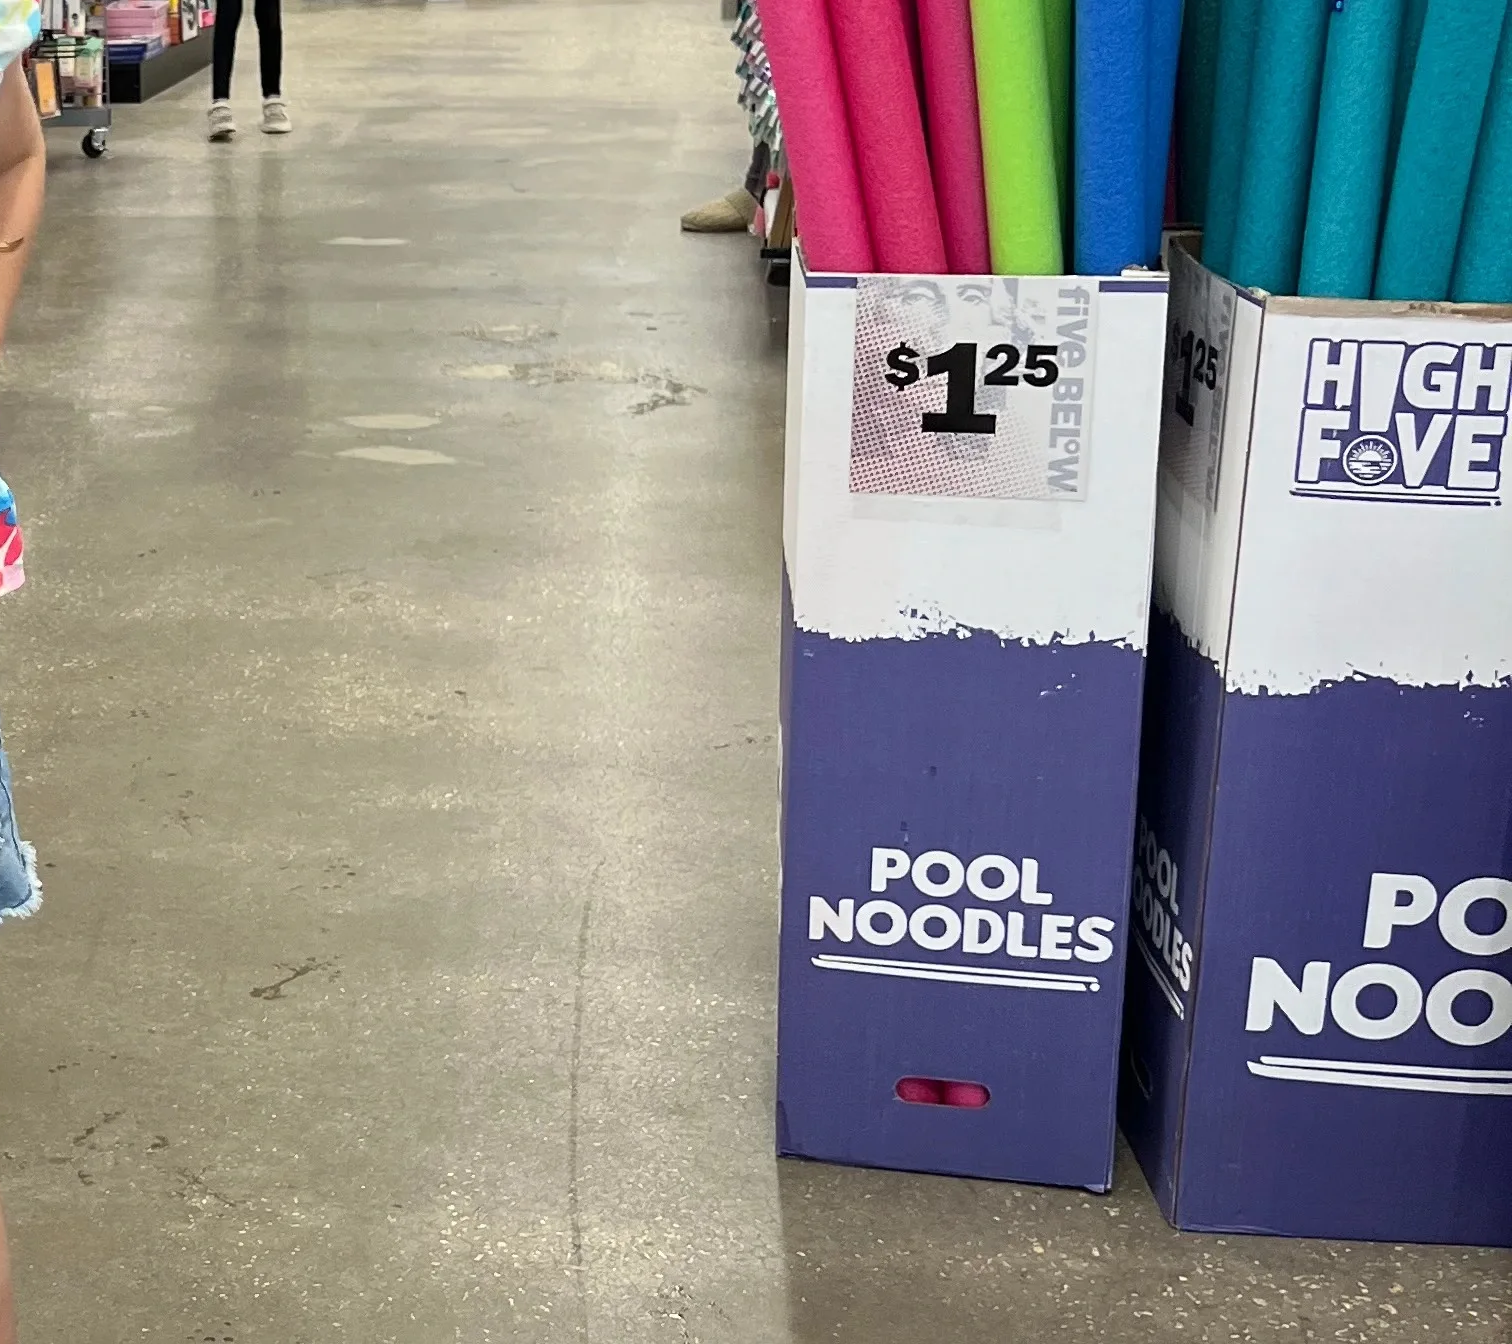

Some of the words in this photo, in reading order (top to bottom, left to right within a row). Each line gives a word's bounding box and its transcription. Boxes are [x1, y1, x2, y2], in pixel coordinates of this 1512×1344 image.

[869, 846, 1053, 906] POOL
[1138, 813, 1179, 917] POOL
[808, 896, 1116, 964] NOODLES
[1133, 863, 1193, 992] OODLES
